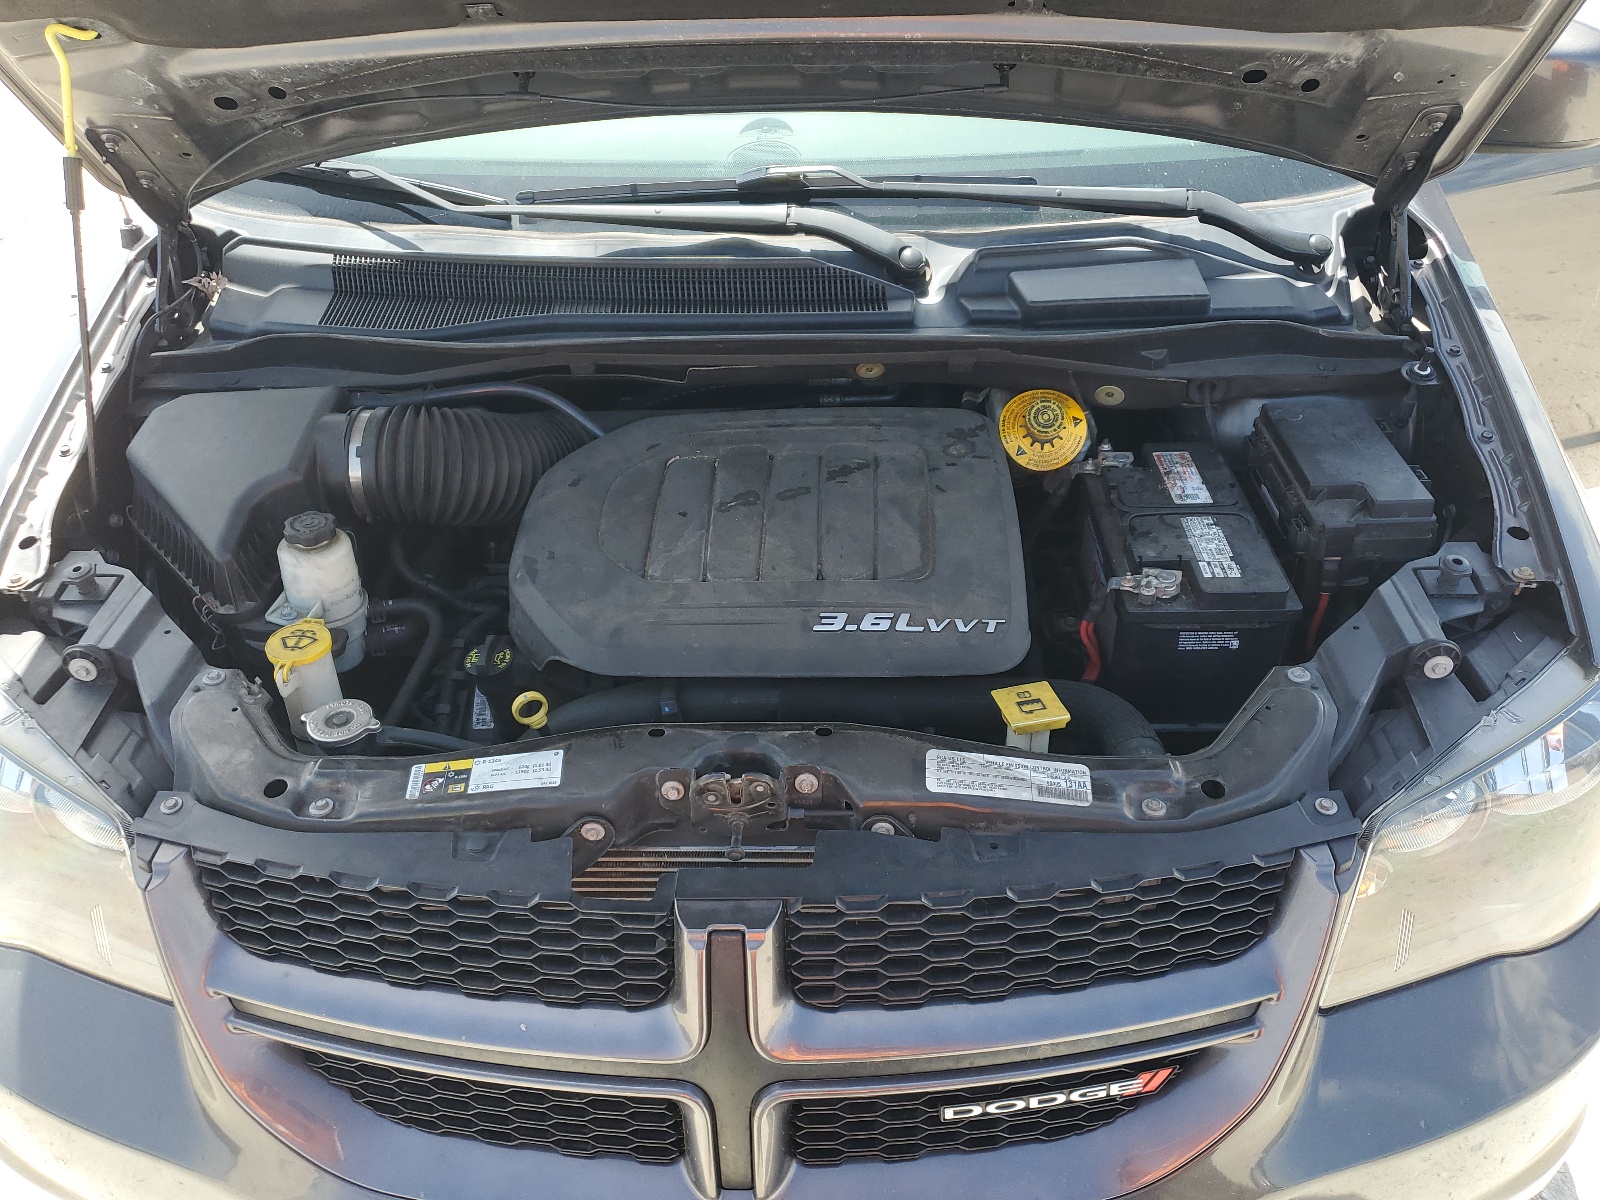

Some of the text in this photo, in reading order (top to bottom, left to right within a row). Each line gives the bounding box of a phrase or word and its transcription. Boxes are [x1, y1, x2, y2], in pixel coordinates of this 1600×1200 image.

[1053, 767, 1087, 775] INFORMATION
[1063, 780, 1088, 789] 131AA
[943, 1077, 1144, 1121] DODGE
